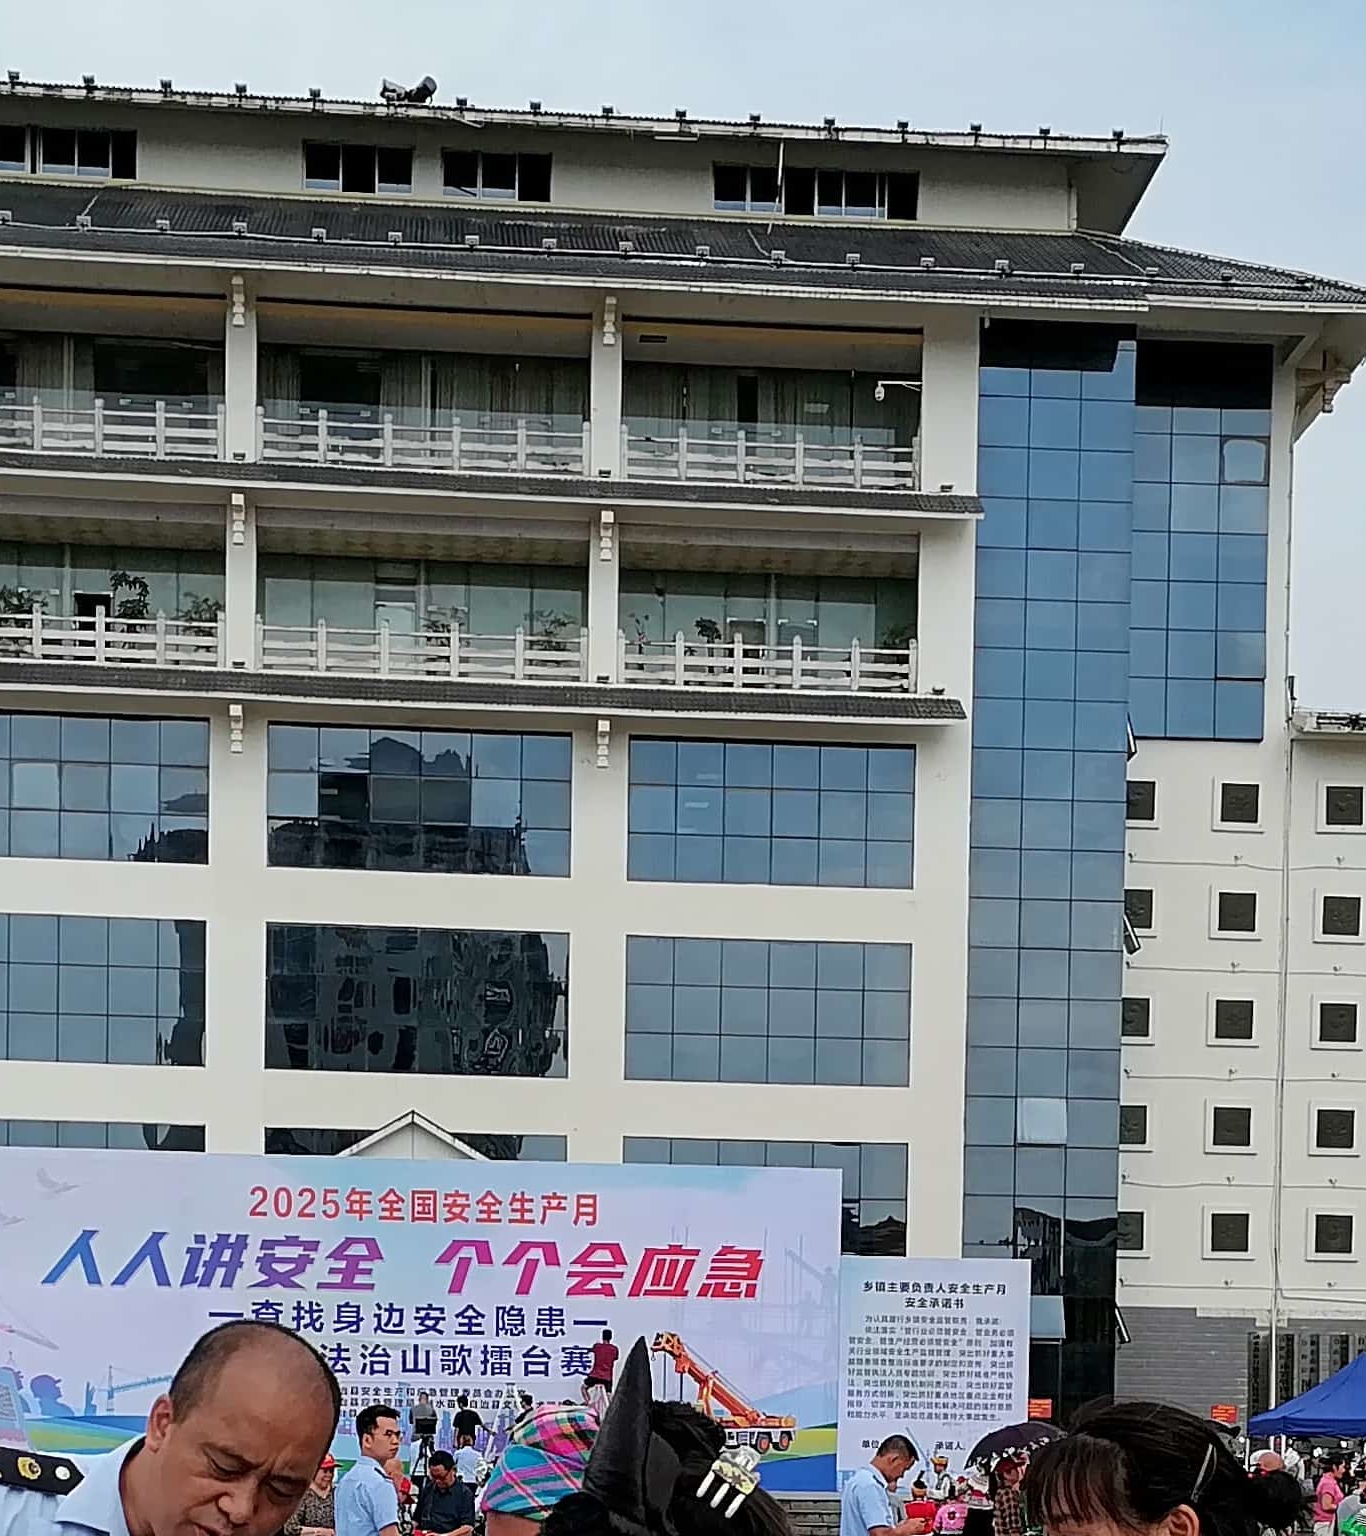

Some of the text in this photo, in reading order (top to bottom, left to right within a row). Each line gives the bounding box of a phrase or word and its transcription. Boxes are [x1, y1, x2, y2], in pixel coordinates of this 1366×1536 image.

[249, 1185, 600, 1229] 2025年全国安全生产月
[40, 1230, 765, 1300] 人人讲安全 个个会应急
[863, 1281, 1005, 1294] 乡镇主要负责人安全生产月
[904, 1297, 963, 1308] 安全承诺书
